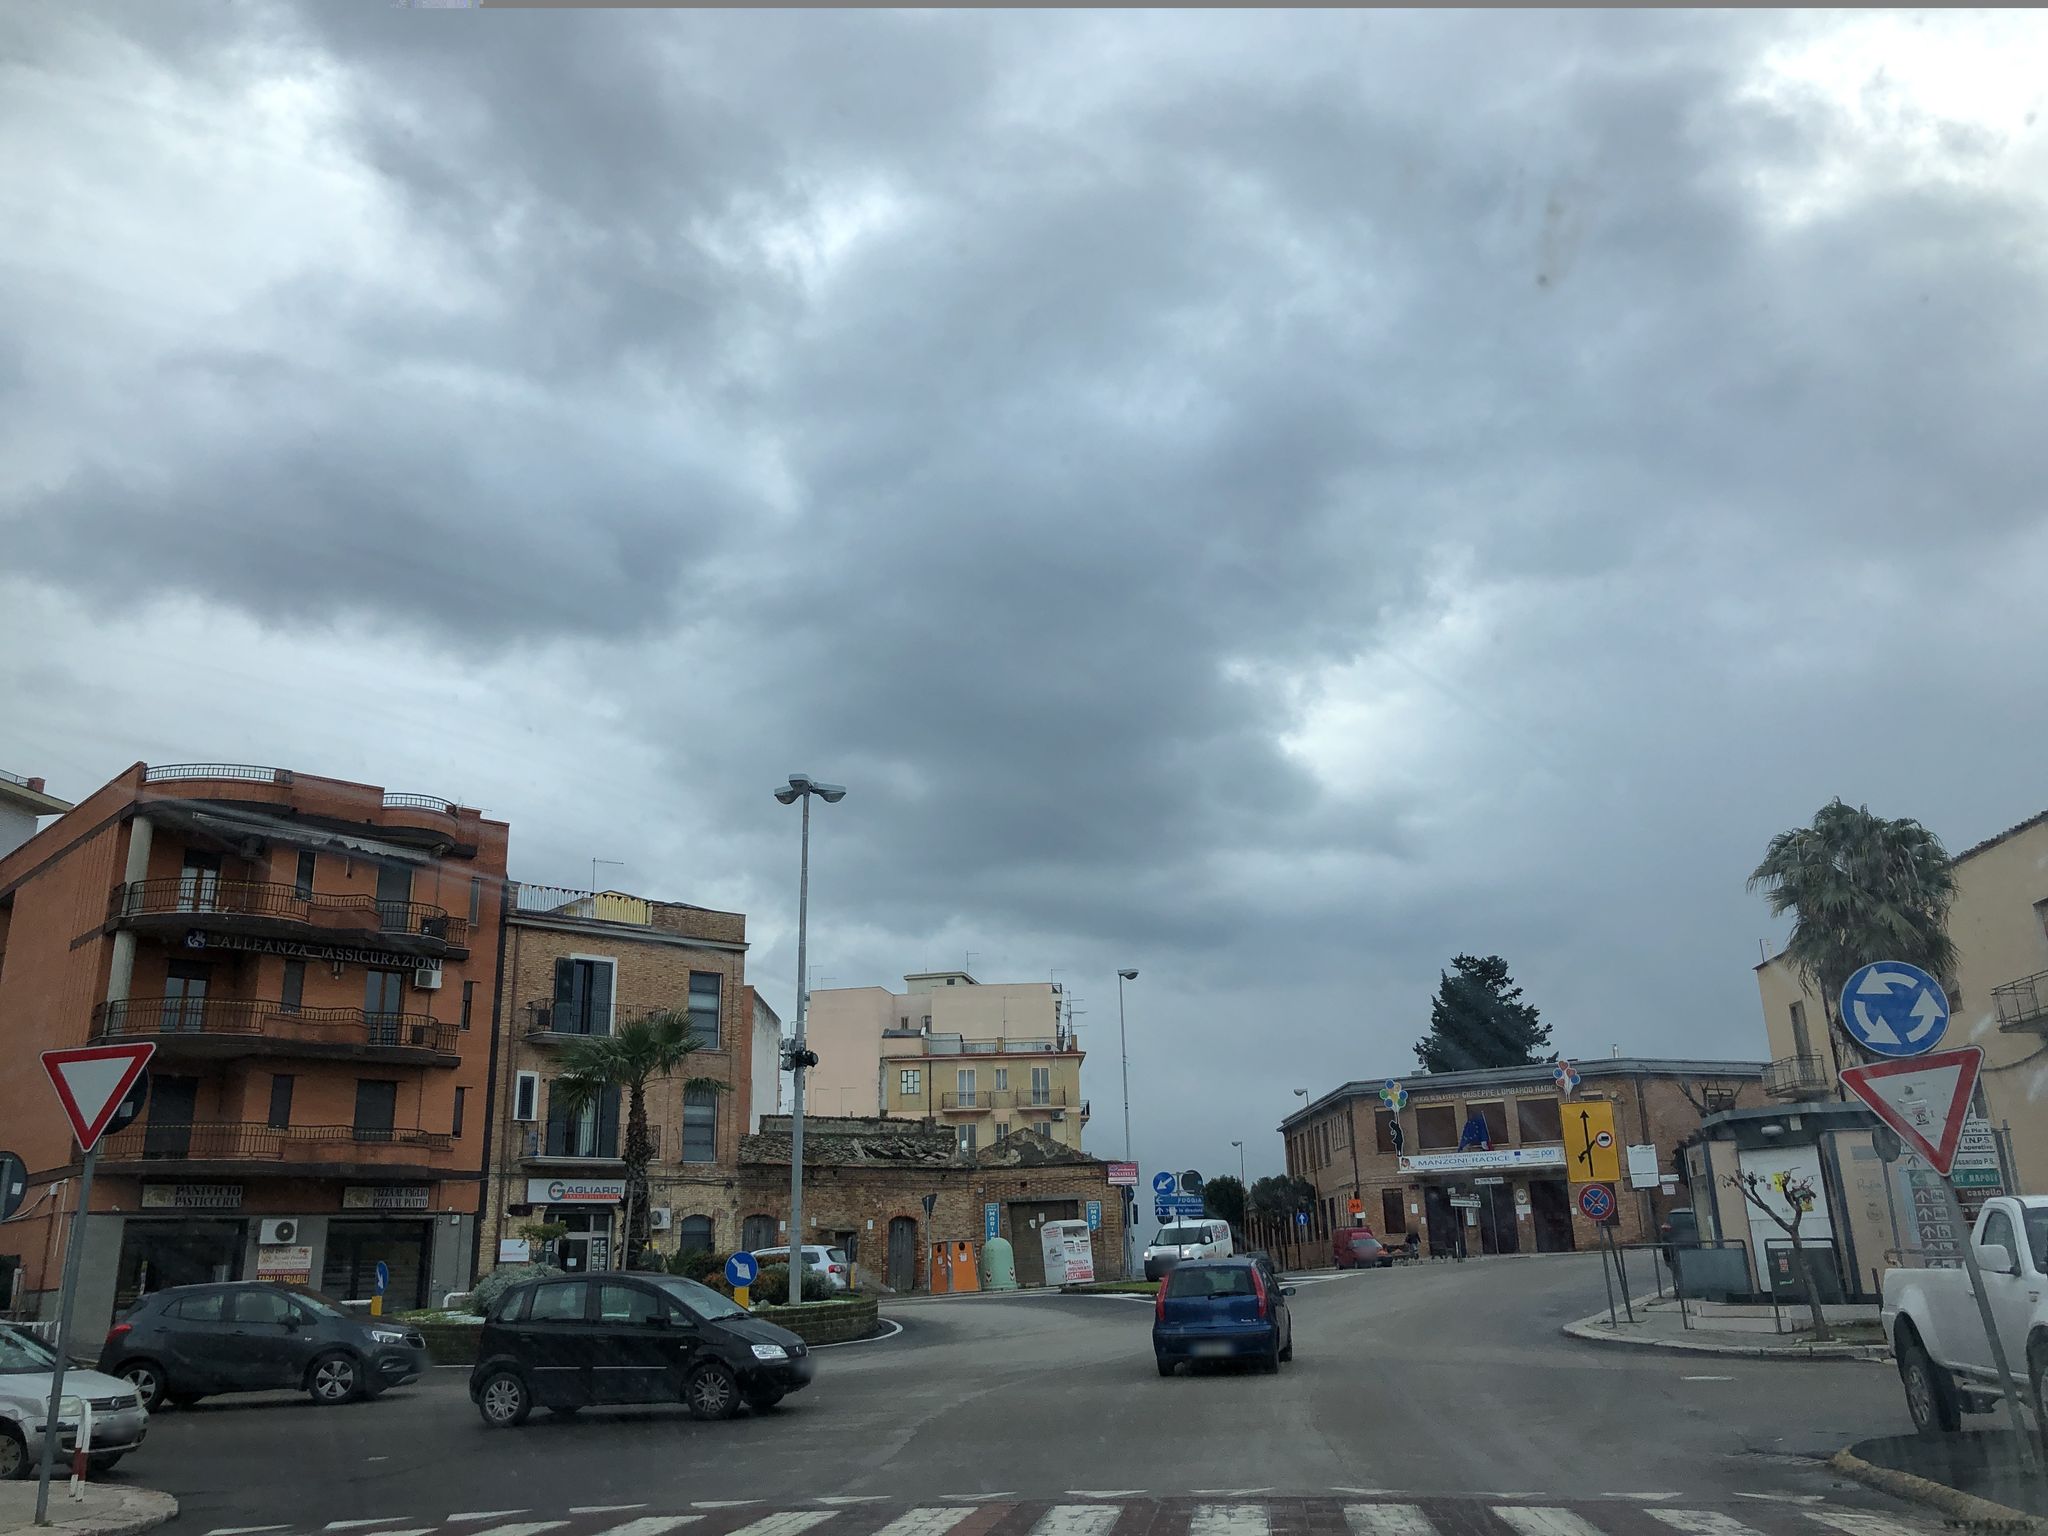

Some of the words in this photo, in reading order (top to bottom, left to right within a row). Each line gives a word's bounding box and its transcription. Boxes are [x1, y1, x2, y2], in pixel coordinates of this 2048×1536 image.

[220, 935, 309, 956] ALLEANZA
[324, 949, 443, 971] ASSICURAZIONI
[1462, 1088, 1495, 1099] GIUSEPPE
[1496, 1085, 1533, 1096] LOMBARDO
[1535, 1083, 1560, 1094] RADICE
[1418, 1155, 1510, 1168] MANZONI-RADICE
[1969, 1174, 1998, 1182] NAPOLI
[175, 1185, 241, 1196] PANIFICIO
[548, 1181, 622, 1201] GAGLIARDI
[1967, 1188, 2002, 1196] castello
[174, 1196, 240, 1207] PASTICCERIA
[373, 1198, 393, 1207] PIZZA
